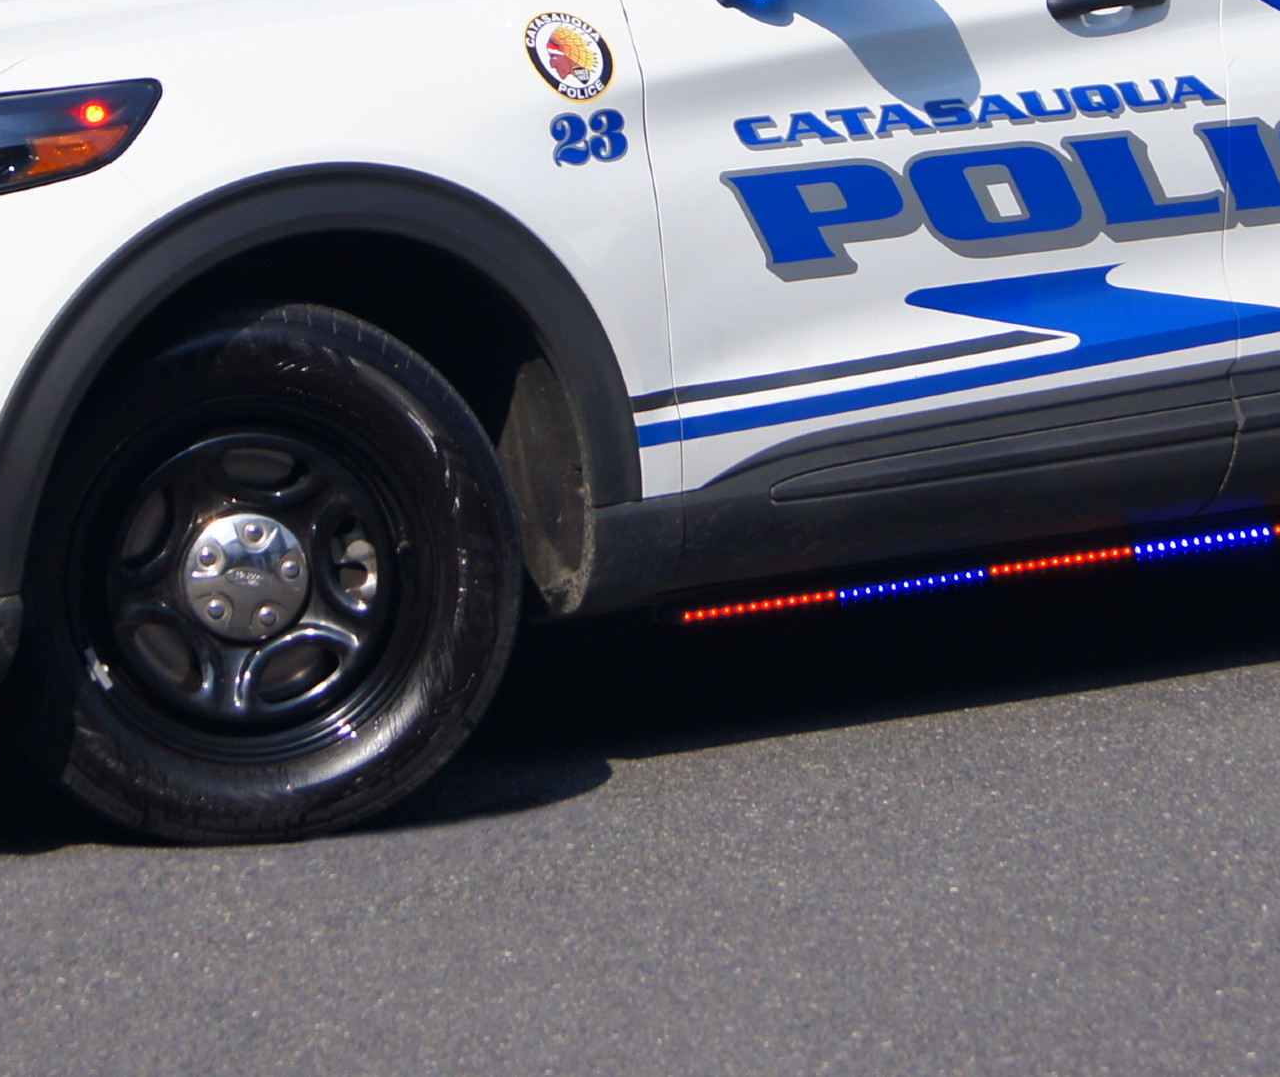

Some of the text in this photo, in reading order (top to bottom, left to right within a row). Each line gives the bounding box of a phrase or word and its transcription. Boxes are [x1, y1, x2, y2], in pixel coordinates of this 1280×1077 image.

[525, 12, 601, 48] CATASAUQUA
[557, 79, 605, 100] POLICE
[733, 74, 1226, 151] CATASAUQUA
[549, 108, 629, 167] 23
